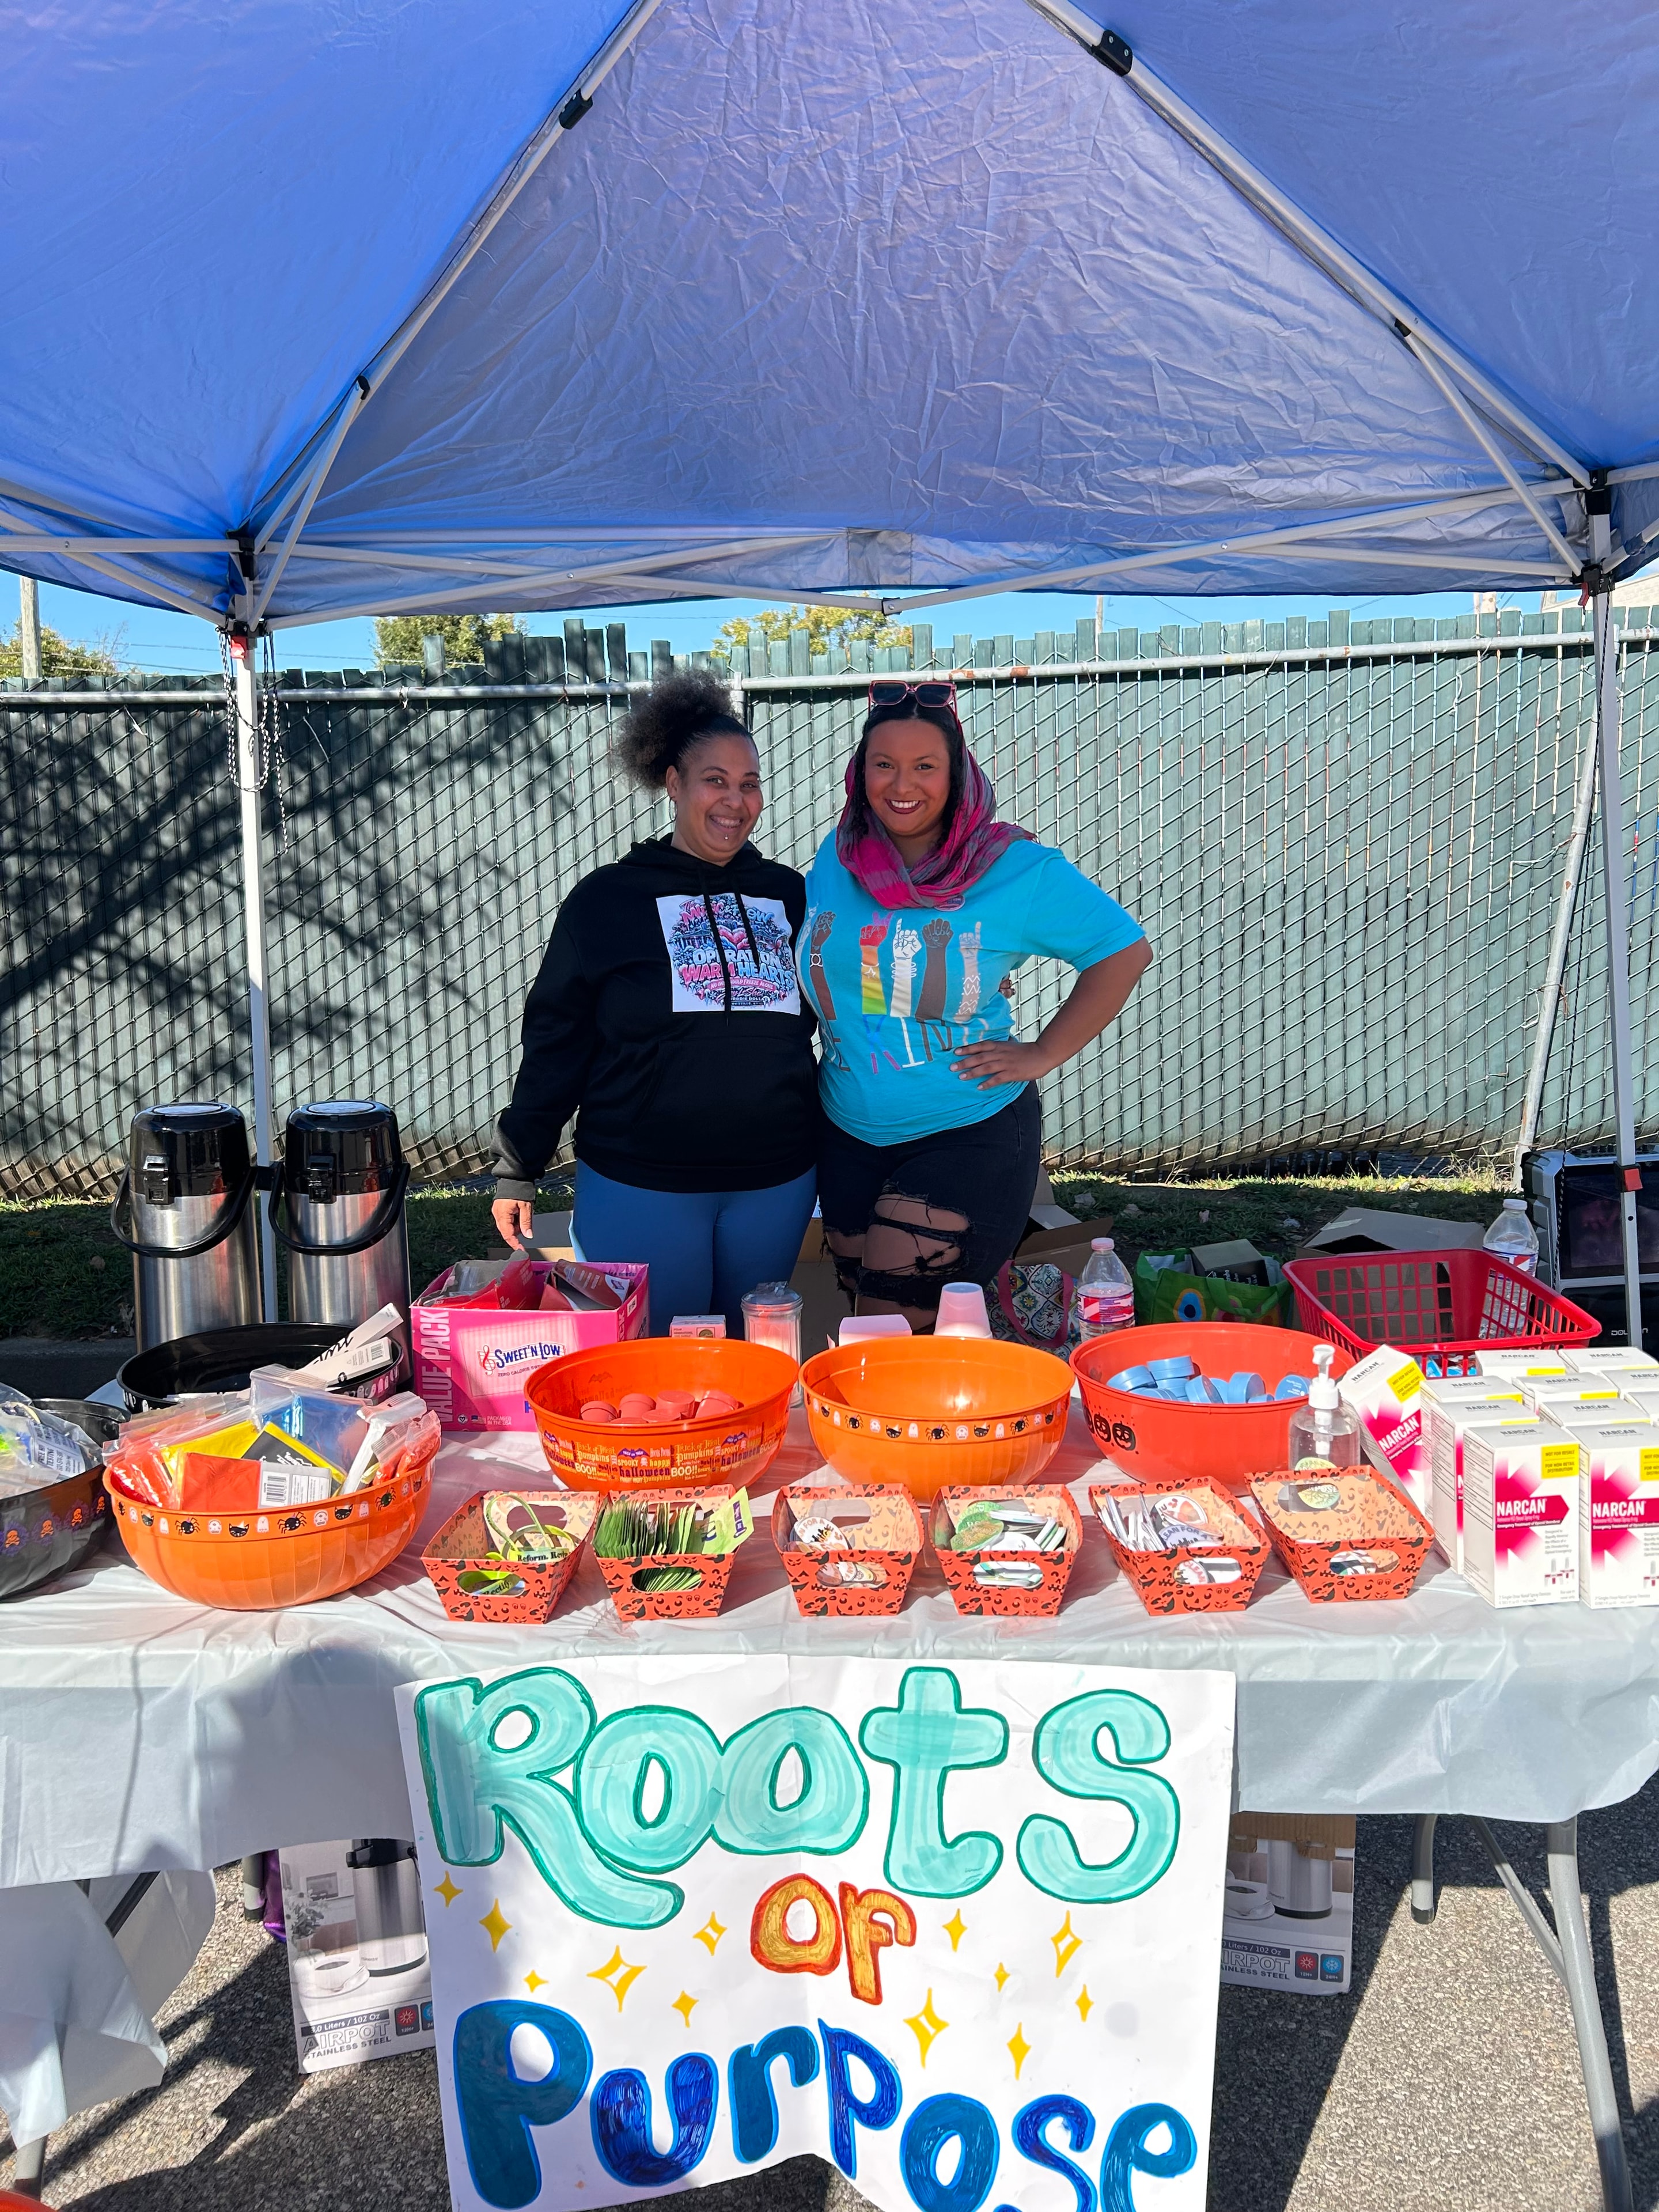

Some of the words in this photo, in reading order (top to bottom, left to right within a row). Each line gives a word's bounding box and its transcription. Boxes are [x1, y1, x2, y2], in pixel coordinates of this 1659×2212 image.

[693, 949, 783, 969] OPRATON
[737, 961, 795, 987] HEARTS
[419, 1310, 452, 1361] PACK
[511, 1367, 531, 1375] CALORIE
[1351, 1361, 1380, 1381] NARCAN
[421, 1366, 453, 1423] VALUE
[1378, 1416, 1420, 1452] NARCAN
[619, 1466, 670, 1478] halloween
[672, 1465, 698, 1477] BOO!!
[1497, 1499, 1546, 1517] NARCAN
[1593, 1501, 1645, 1518] NARCAN
[1181, 1527, 1200, 1535] FOR
[414, 1666, 1181, 1930] Roots
[1228, 1942, 1248, 1950] Liters
[1255, 1945, 1270, 1954] 102
[1260, 1971, 1290, 1980] STEEL
[324, 2021, 346, 2031] Liters
[353, 2016, 367, 2024] 102
[303, 2021, 391, 2054] AIRPOT
[304, 2043, 358, 2059] STAINLESS
[361, 2036, 392, 2048] STEEL
